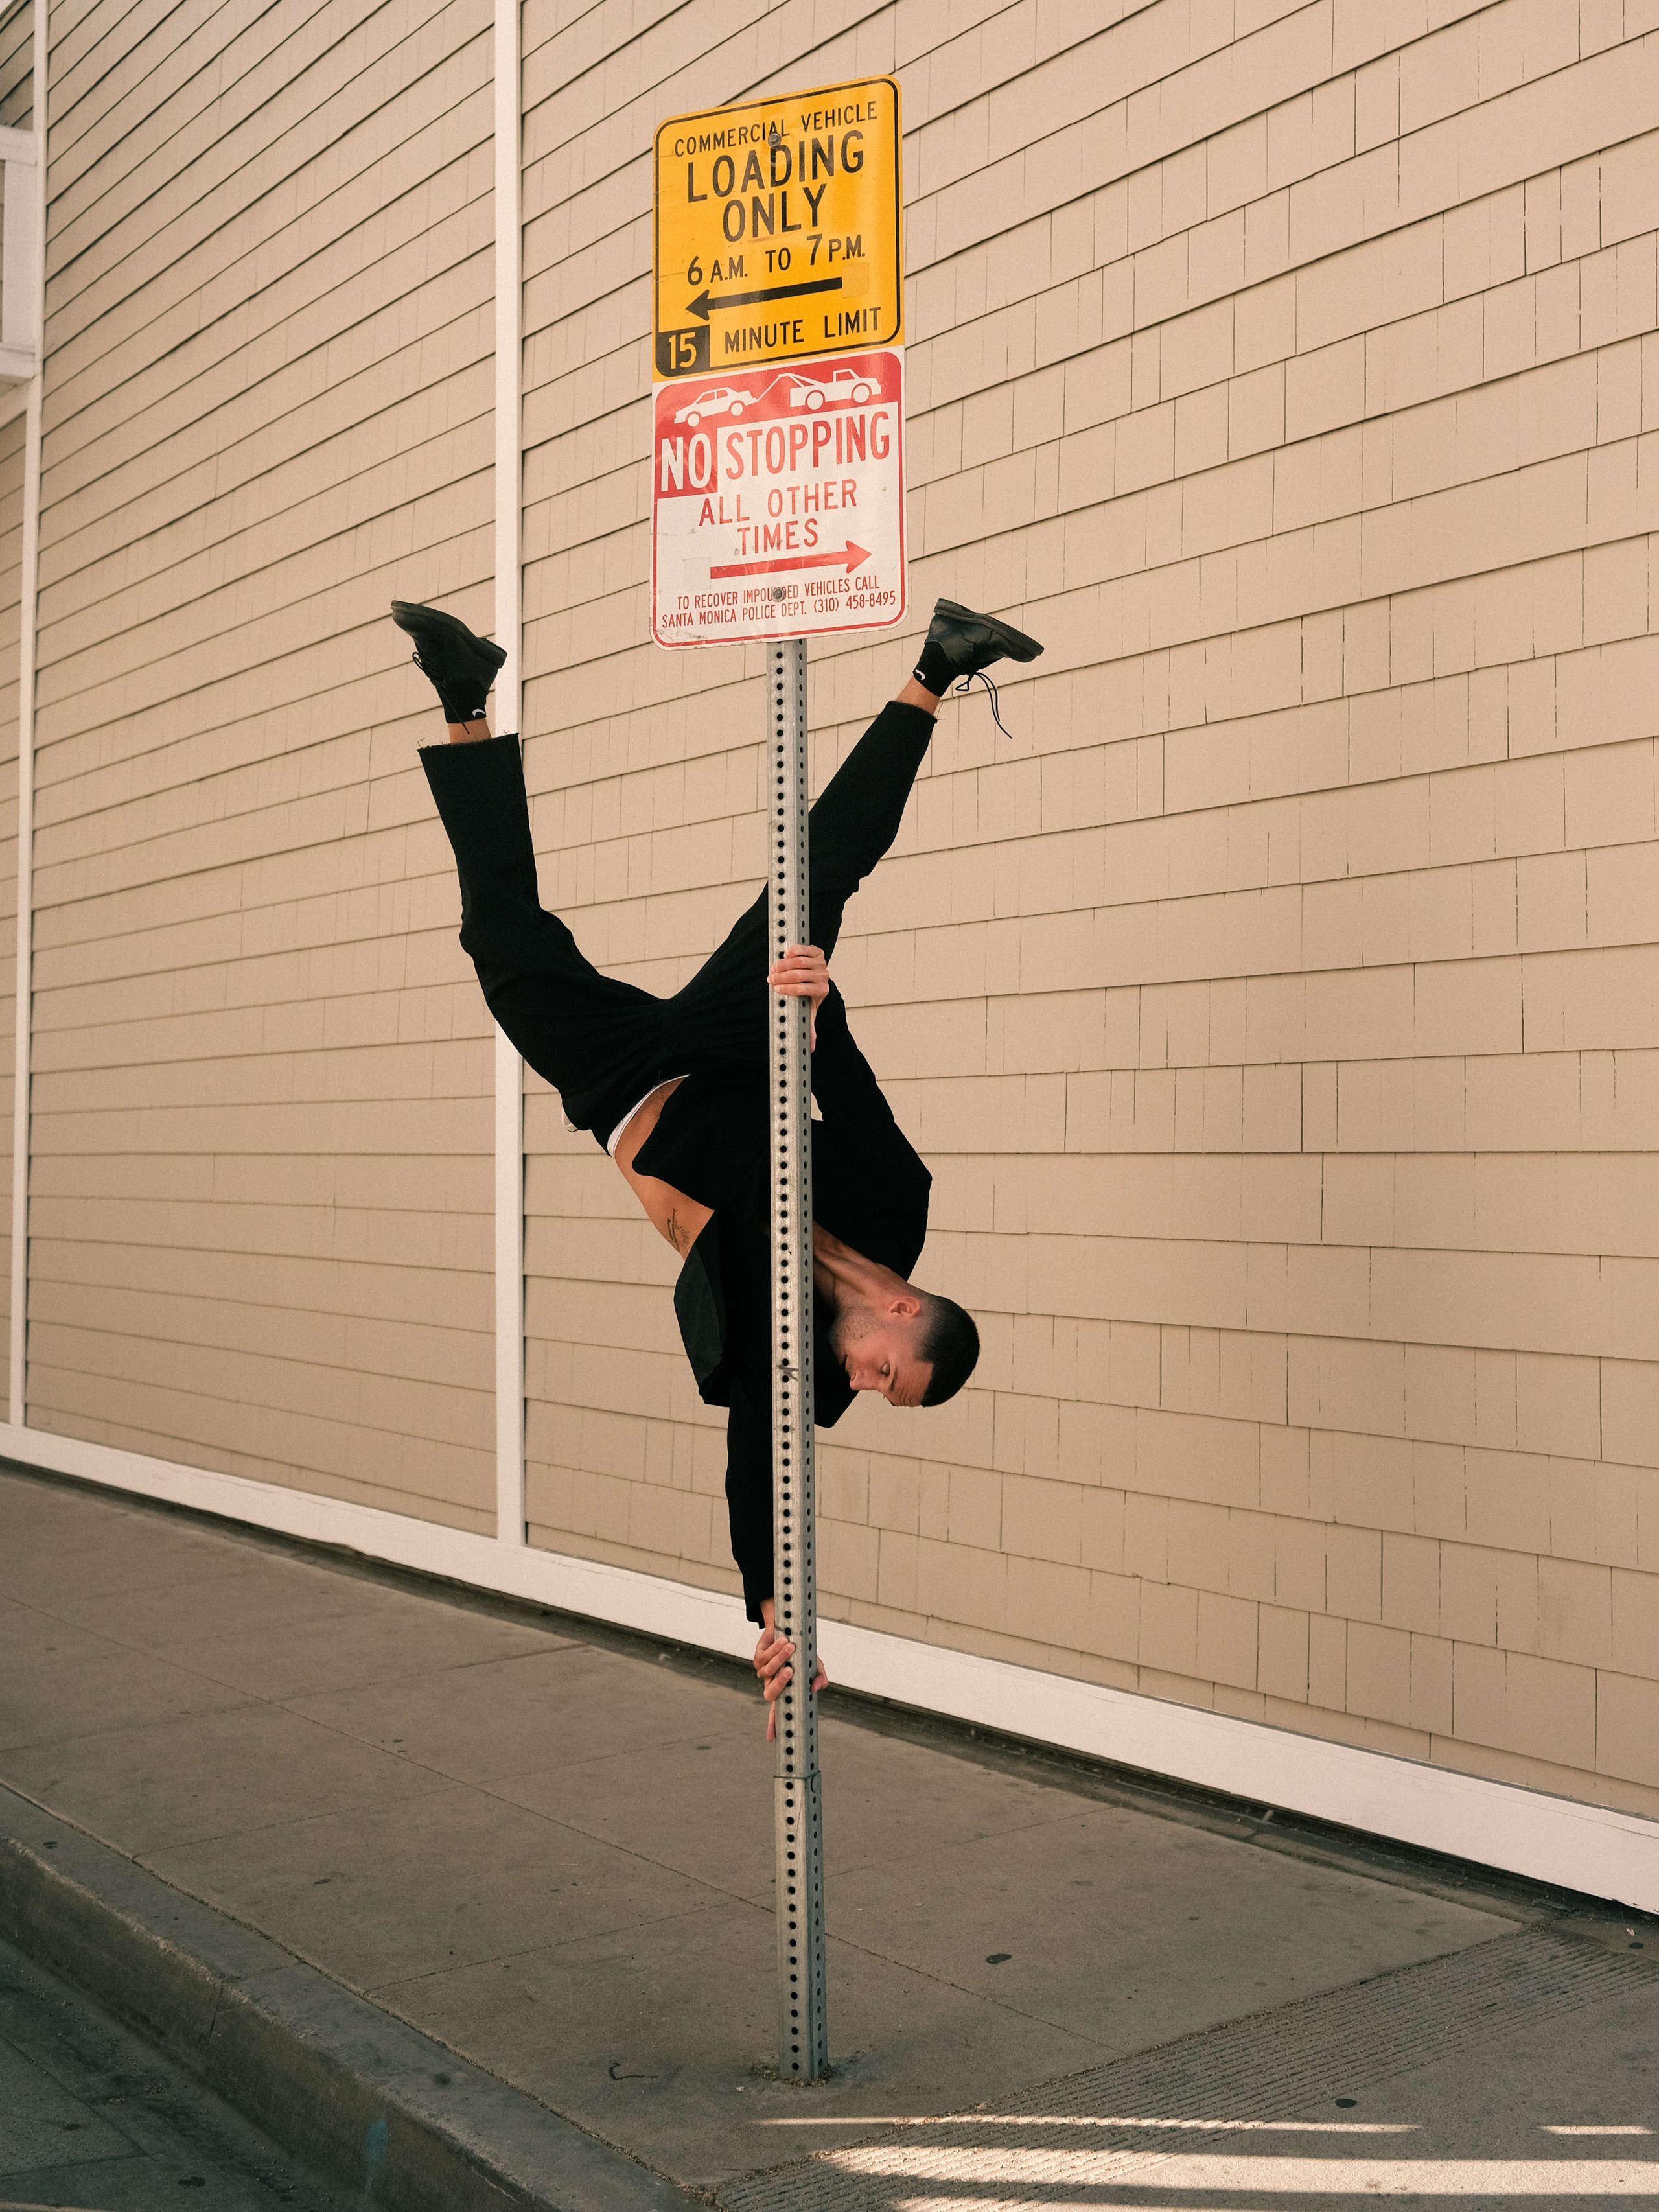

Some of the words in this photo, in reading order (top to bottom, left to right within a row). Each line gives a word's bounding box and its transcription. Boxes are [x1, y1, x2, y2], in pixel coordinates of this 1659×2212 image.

[675, 119, 791, 157] COMMERCIAL
[801, 100, 877, 132] VEHICLE
[688, 130, 864, 204] LOADING
[723, 183, 827, 242] ONLY
[687, 255, 703, 286] 6
[710, 255, 748, 283] A.M.
[765, 247, 791, 273] TO
[806, 233, 823, 266] 7
[829, 234, 866, 262] P.M.
[668, 331, 697, 370] 15
[725, 319, 804, 355] MINUTE
[824, 307, 881, 338] LIMIT
[661, 432, 712, 492] NO
[726, 410, 890, 480] STOPPING
[699, 494, 750, 527] ALL
[767, 478, 857, 518] OTHER
[737, 518, 819, 555] TIMES
[662, 611, 694, 629] SANTA
[699, 607, 737, 625] MONICA
[742, 604, 776, 622] POLICE
[781, 601, 807, 617] DEPT.
[813, 597, 839, 614] (310)
[846, 590, 896, 609] 458-8495
[677, 596, 690, 611] TO
[694, 591, 738, 609] RECOVER
[743, 585, 799, 604] IMPOUDED
[804, 577, 850, 597] VEHICLES
[855, 574, 880, 591] CALL
